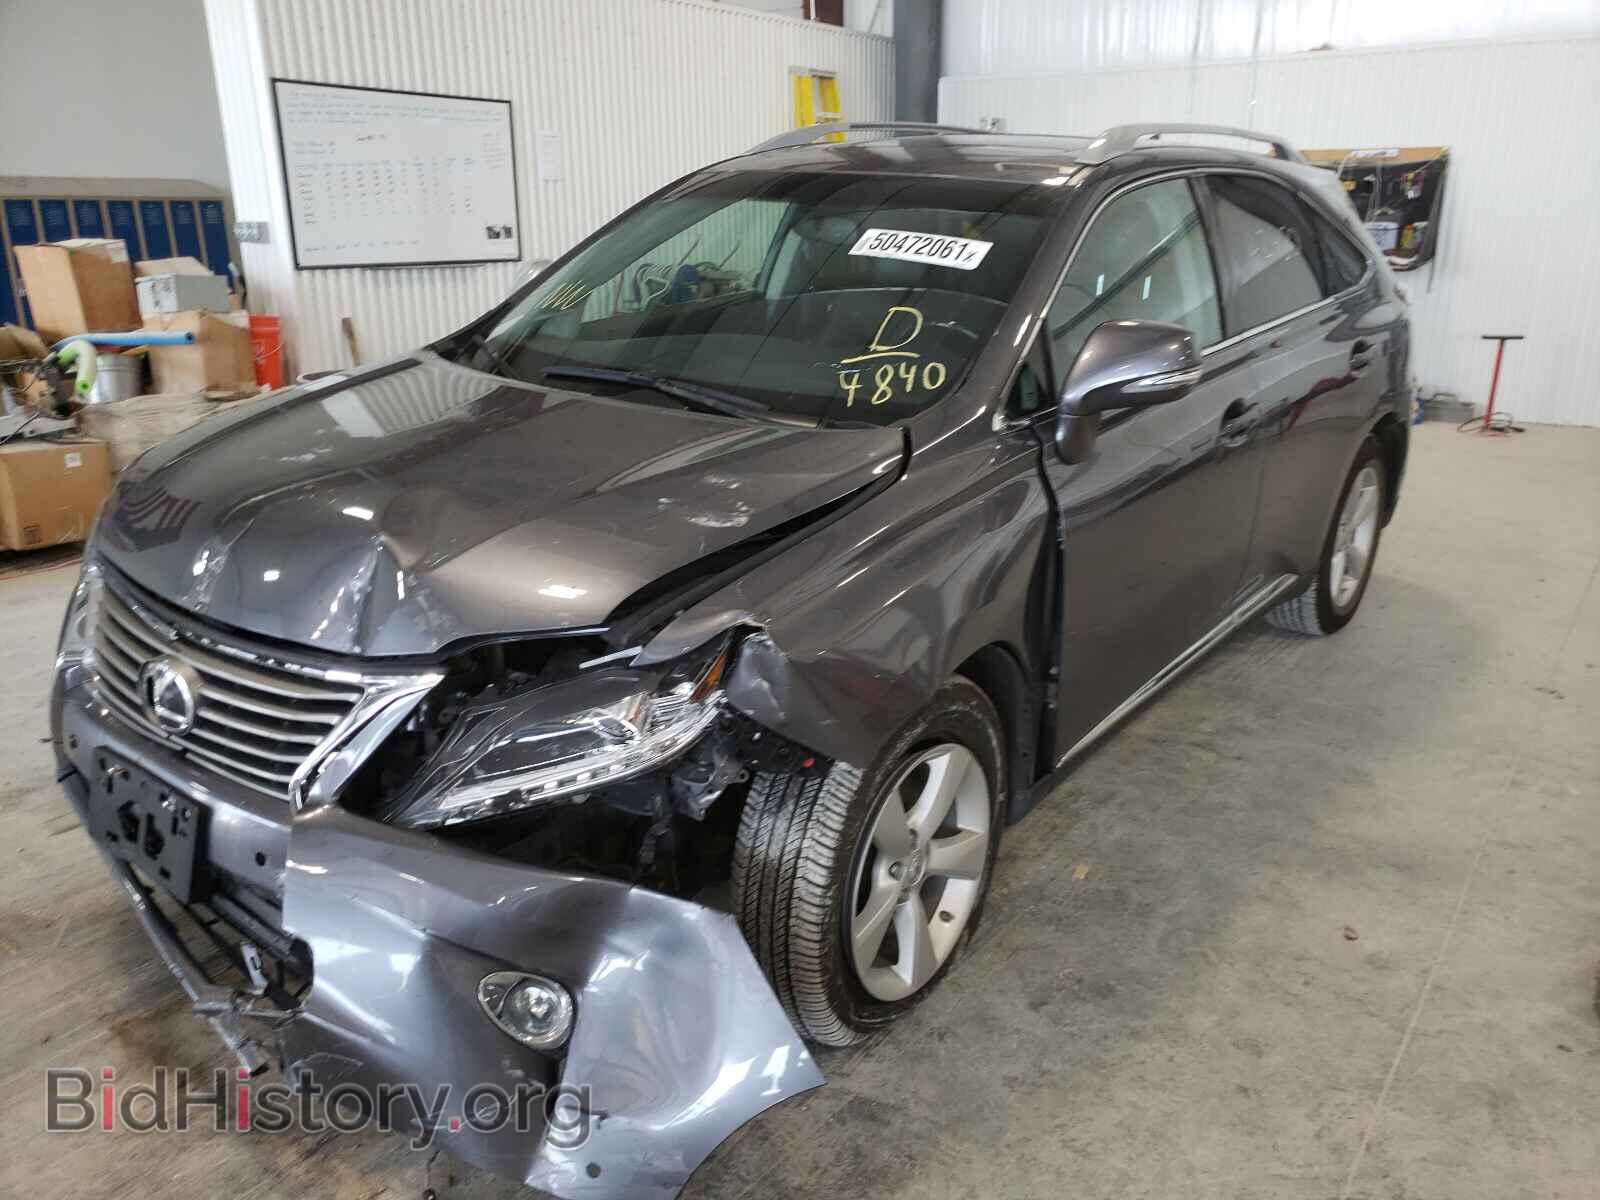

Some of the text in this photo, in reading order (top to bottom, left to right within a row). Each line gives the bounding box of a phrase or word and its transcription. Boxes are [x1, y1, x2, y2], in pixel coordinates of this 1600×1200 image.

[869, 232, 969, 261] 50472061
[869, 306, 924, 351] D
[838, 361, 947, 408] 4840
